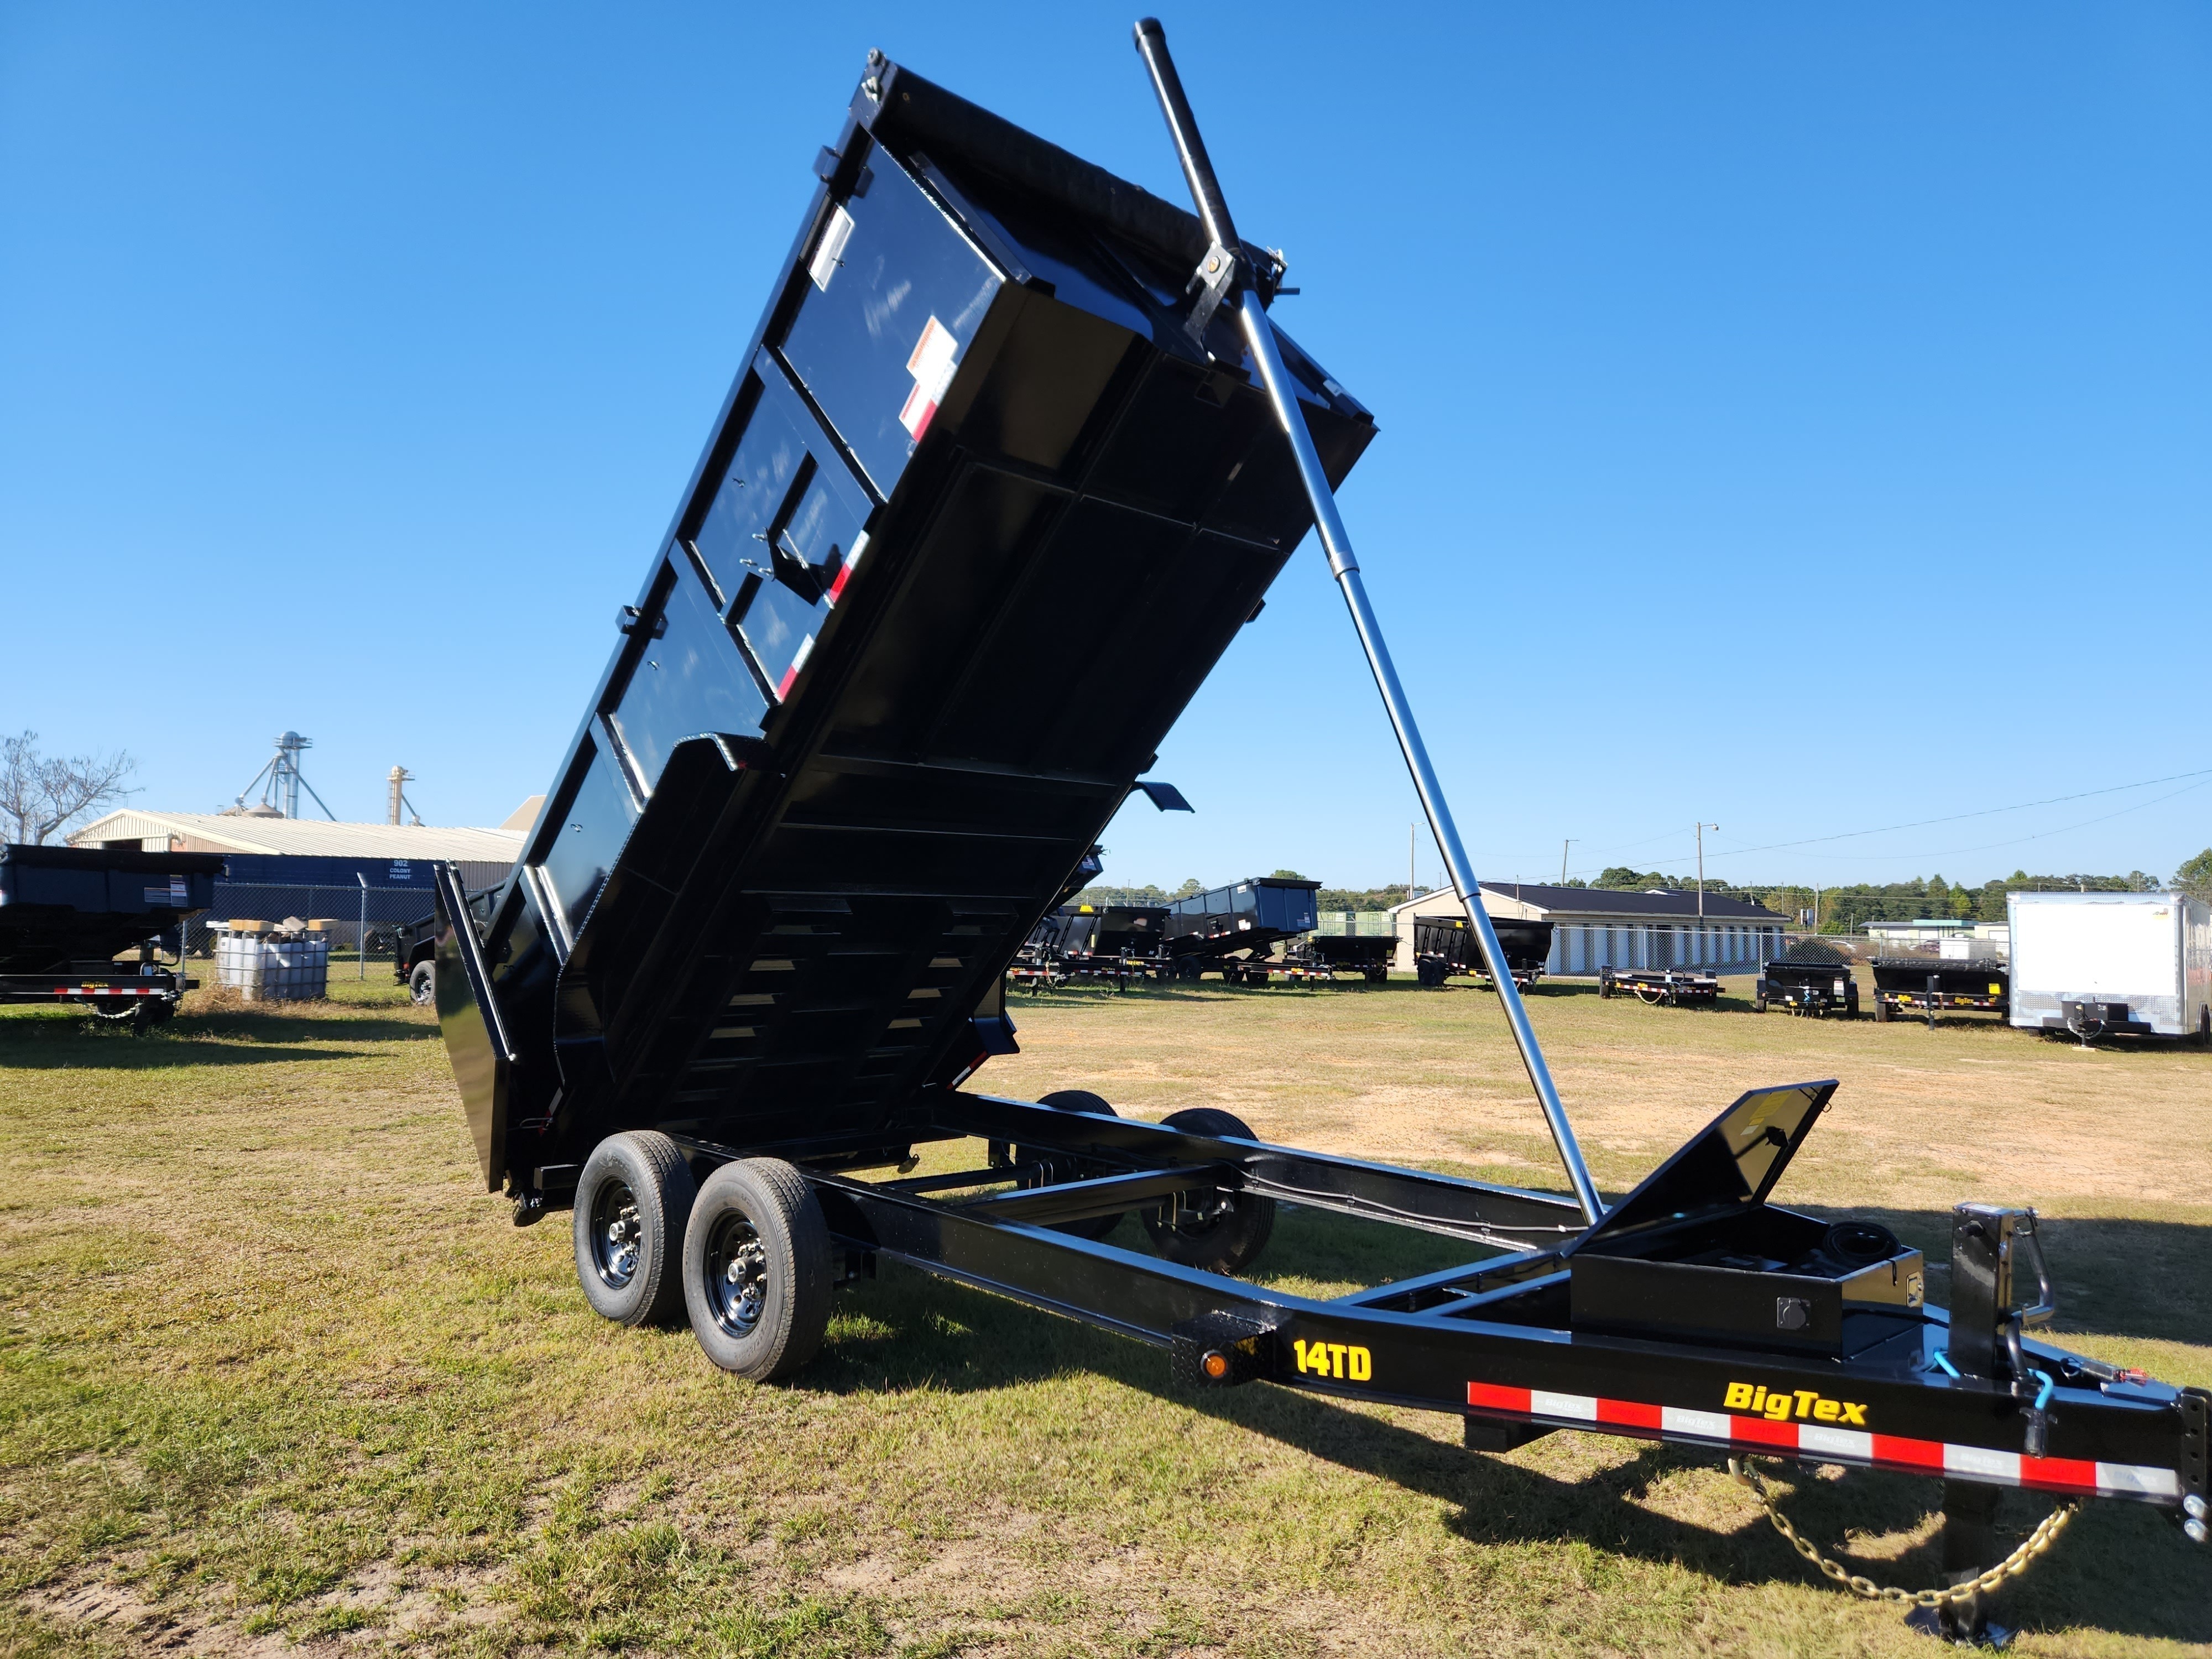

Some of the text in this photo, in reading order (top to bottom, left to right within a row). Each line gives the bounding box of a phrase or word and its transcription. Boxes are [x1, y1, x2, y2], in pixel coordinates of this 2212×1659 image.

[915, 324, 934, 359] WARNING
[81, 980, 109, 989] BigTex
[1954, 997, 1974, 1005] BigTex
[1293, 1339, 1371, 1381] 14TD
[1545, 1398, 1582, 1410] BigTex
[1723, 1382, 1869, 1426] BigTex
[1676, 1415, 1716, 1427] BigTex
[1814, 1432, 1855, 1445] BigTex
